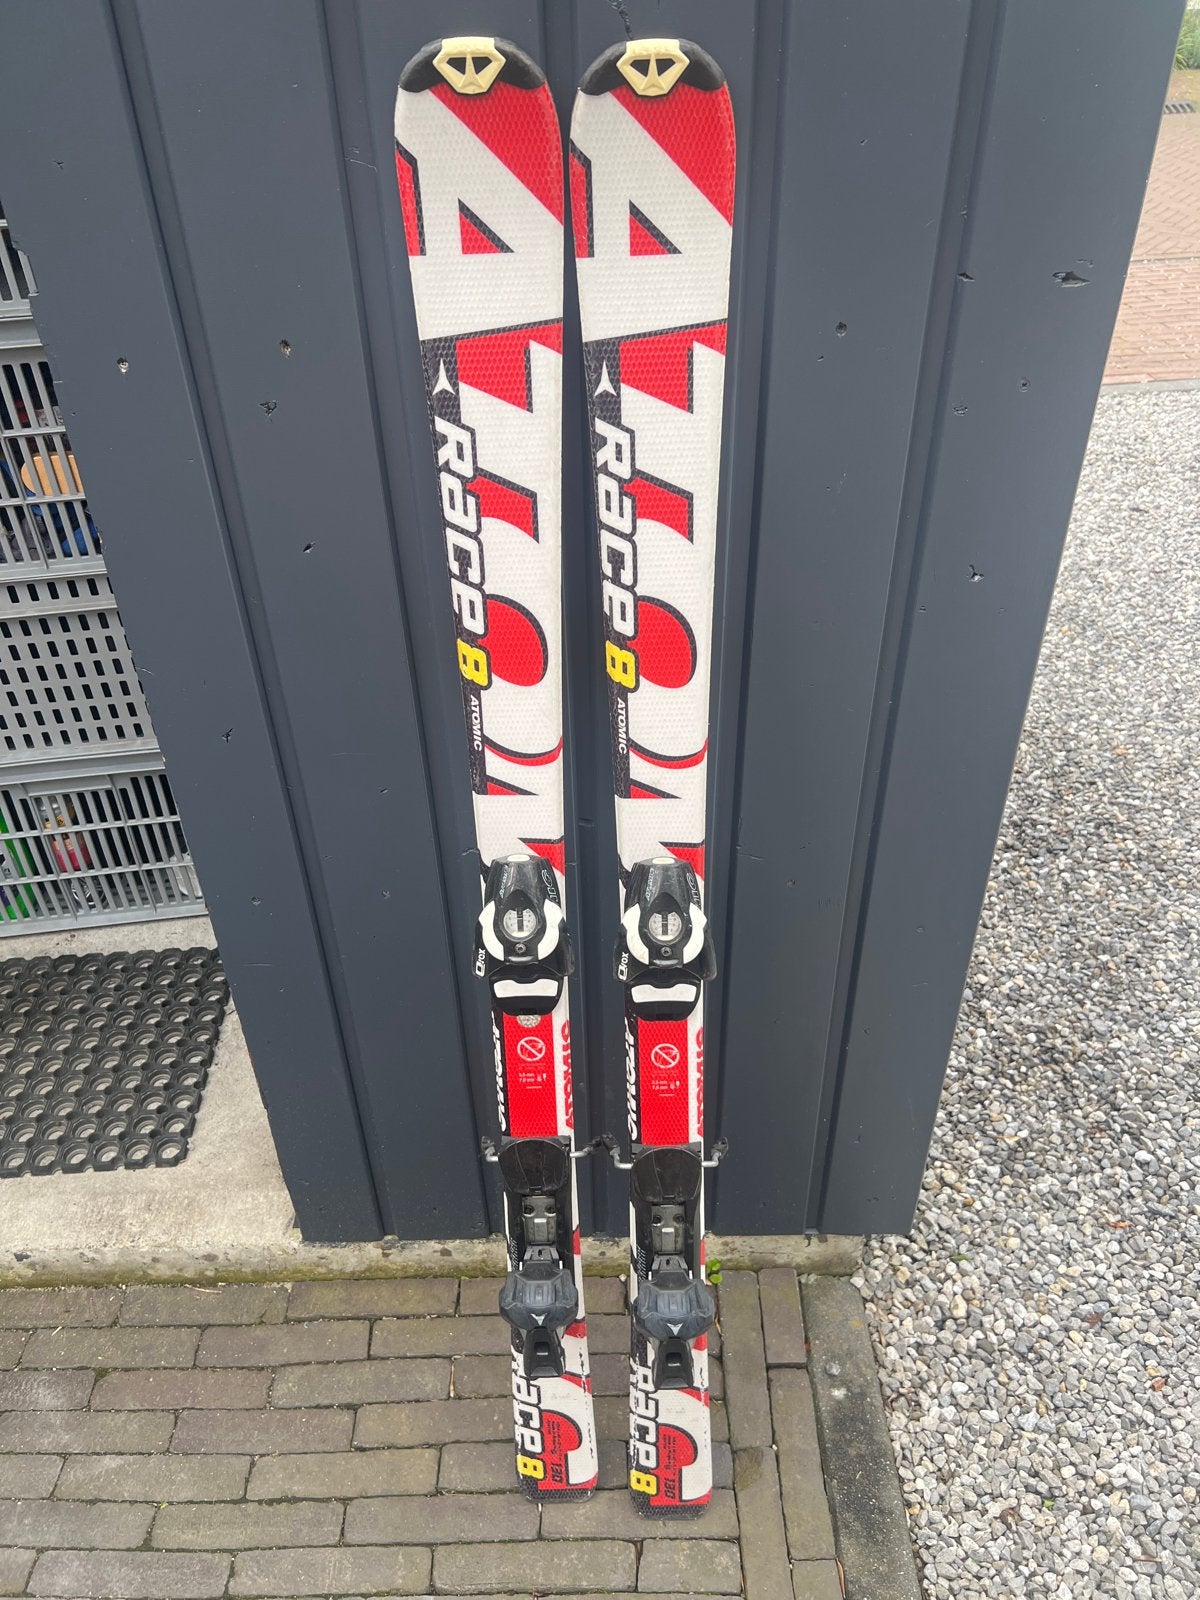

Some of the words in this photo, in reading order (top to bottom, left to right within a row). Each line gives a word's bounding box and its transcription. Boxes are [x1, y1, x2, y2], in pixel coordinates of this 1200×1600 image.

[434, 415, 485, 636] Race
[594, 417, 635, 638] Race
[457, 638, 489, 687] 8
[606, 639, 636, 689] 8
[470, 694, 482, 752] ATOMIC
[617, 697, 628, 755] ATOMIC
[516, 1454, 545, 1480] 8
[551, 1462, 563, 1484] 130
[629, 1469, 658, 1496] 8
[664, 1477, 676, 1500] 130
